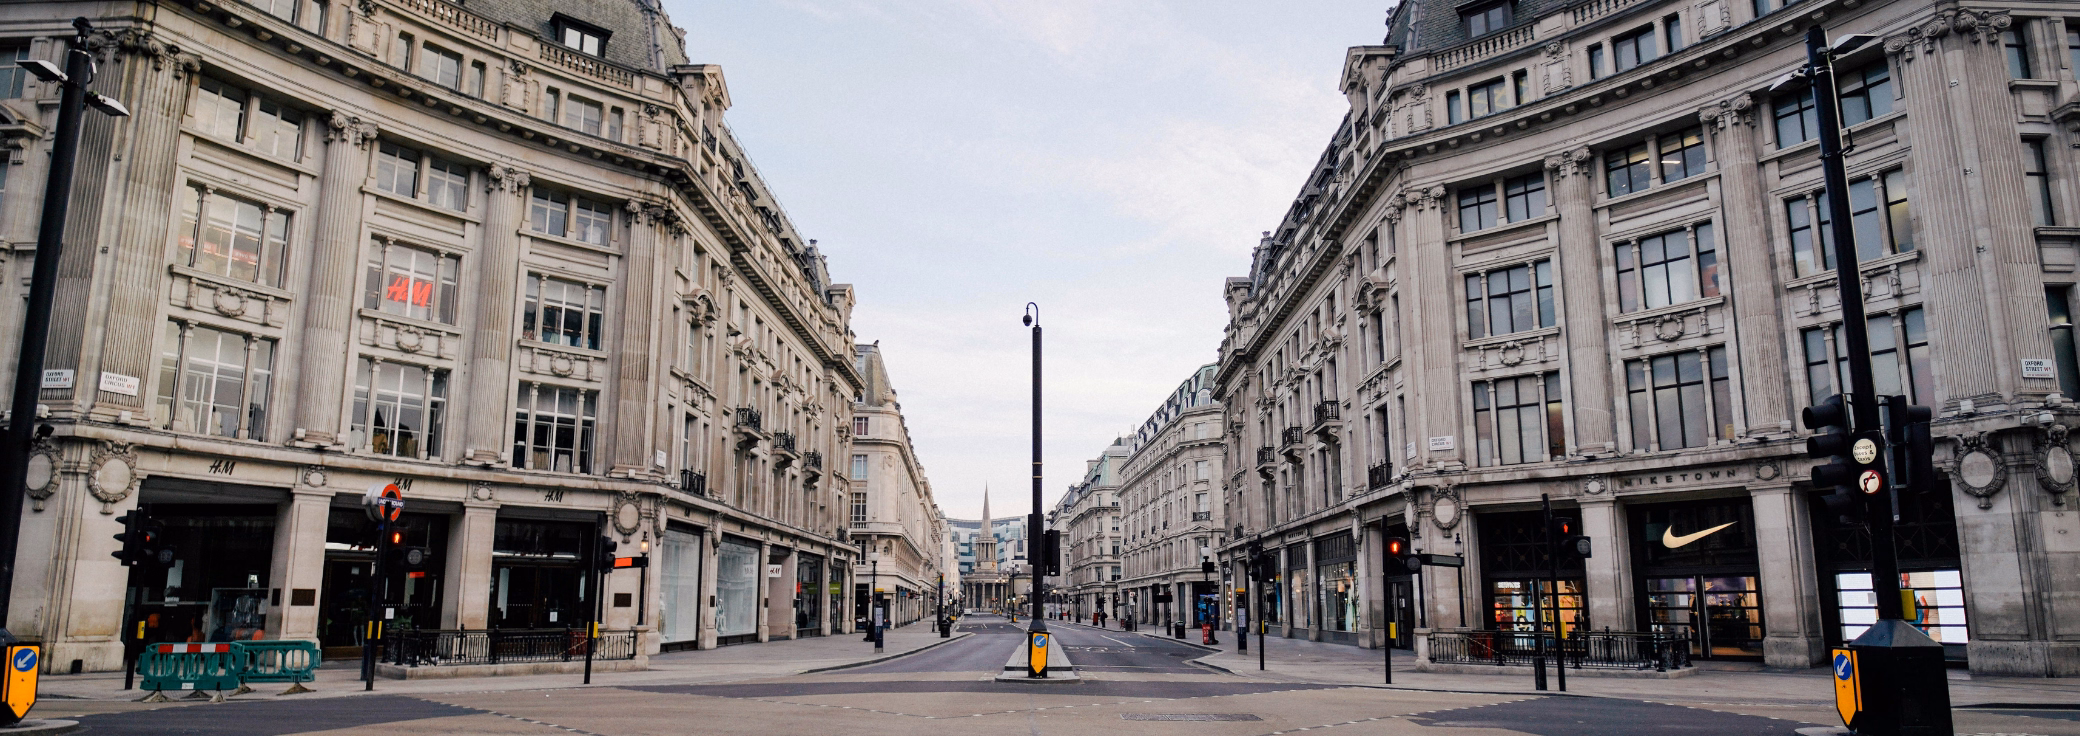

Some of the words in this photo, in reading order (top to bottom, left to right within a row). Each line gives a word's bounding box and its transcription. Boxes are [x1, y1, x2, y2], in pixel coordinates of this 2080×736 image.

[105, 374, 128, 382] OXFORD
[104, 380, 125, 388] CIRCUS
[208, 460, 236, 475] H&M
[1624, 469, 1736, 487] NIKETOWN
